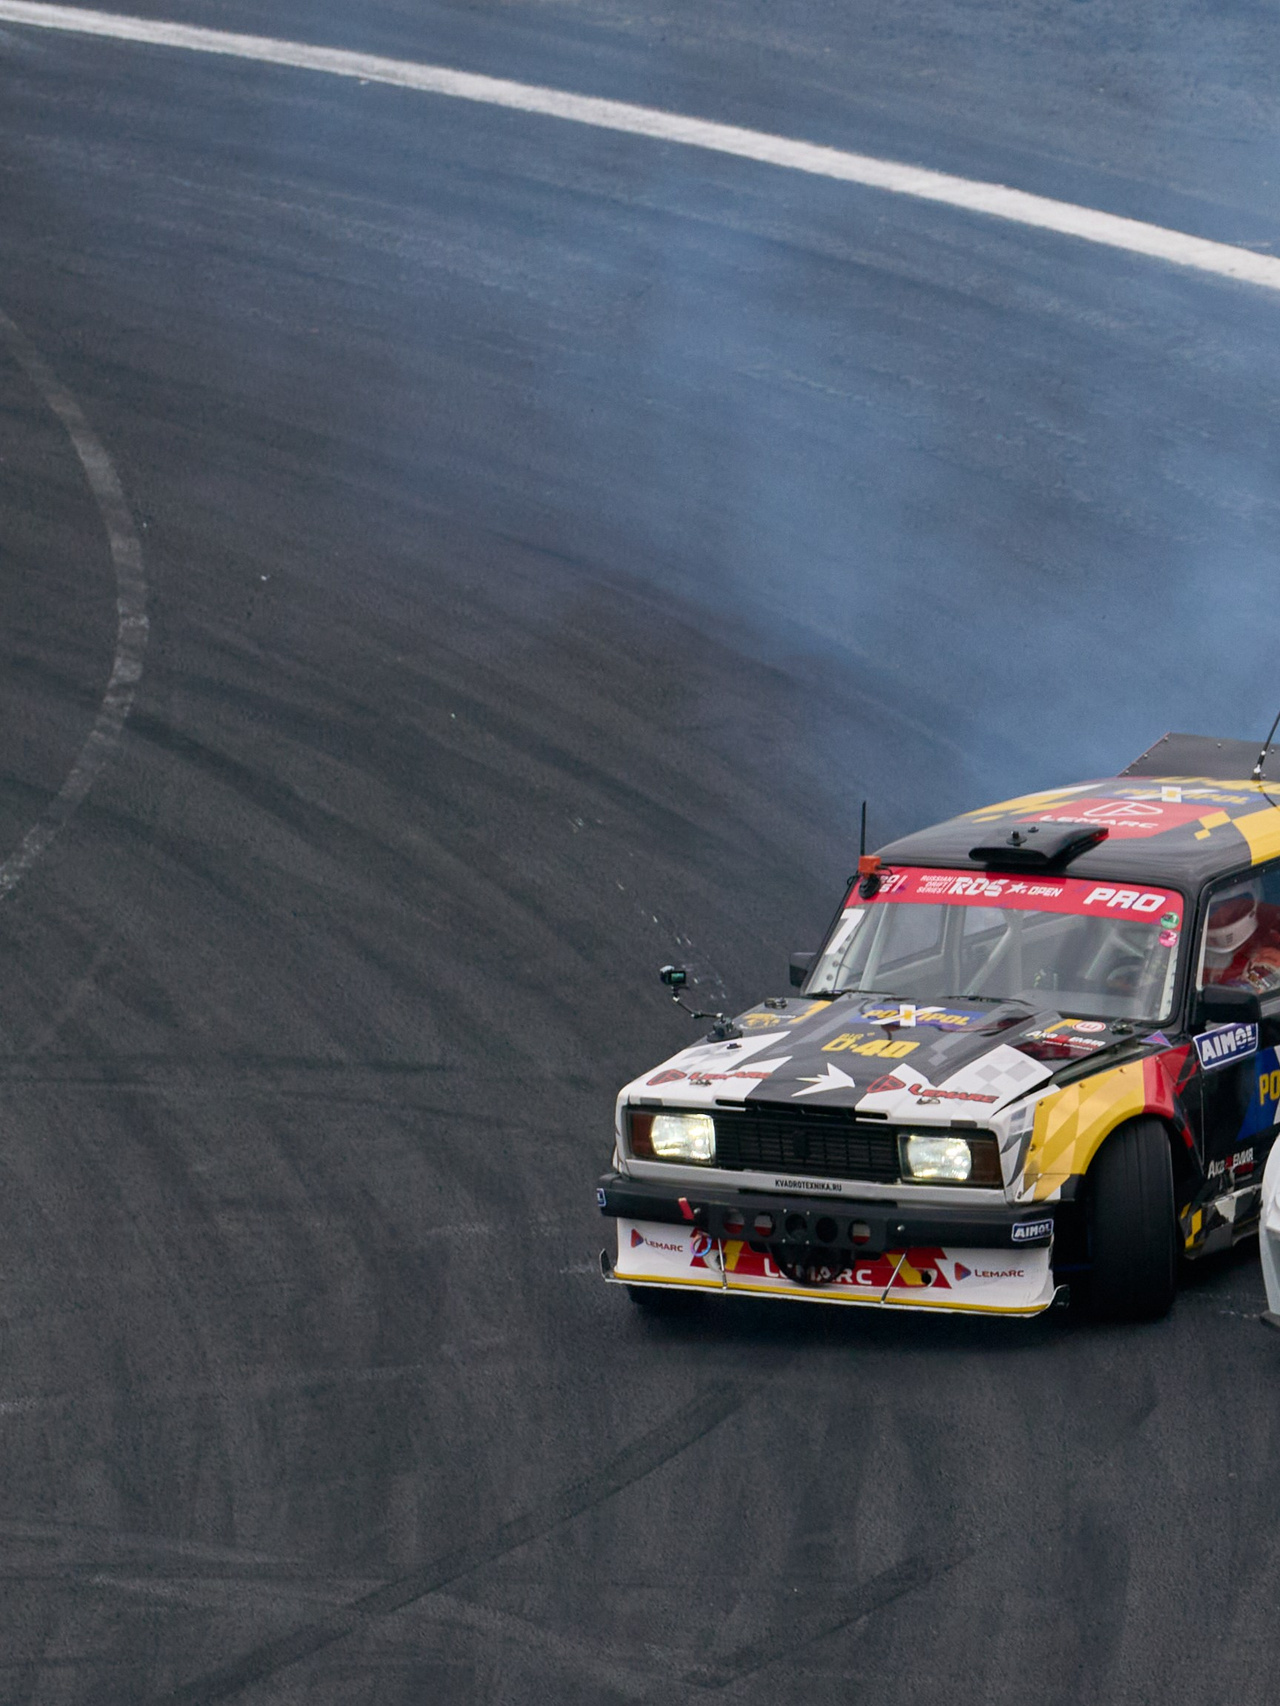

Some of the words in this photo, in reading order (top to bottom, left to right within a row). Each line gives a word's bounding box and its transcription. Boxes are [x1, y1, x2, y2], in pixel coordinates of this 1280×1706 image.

[948, 876, 1010, 898] RDS
[1027, 886, 1064, 898] OPEN
[1082, 887, 1167, 912] PRO
[862, 1004, 971, 1027] POXIPOL
[1201, 1025, 1257, 1062] AIMOL
[774, 1178, 843, 1192] KVADROTEXNIKA.RU
[1014, 1221, 1051, 1239] AIMOL
[644, 1237, 684, 1253] LEMARC
[974, 1268, 1025, 1279] LEMARC
